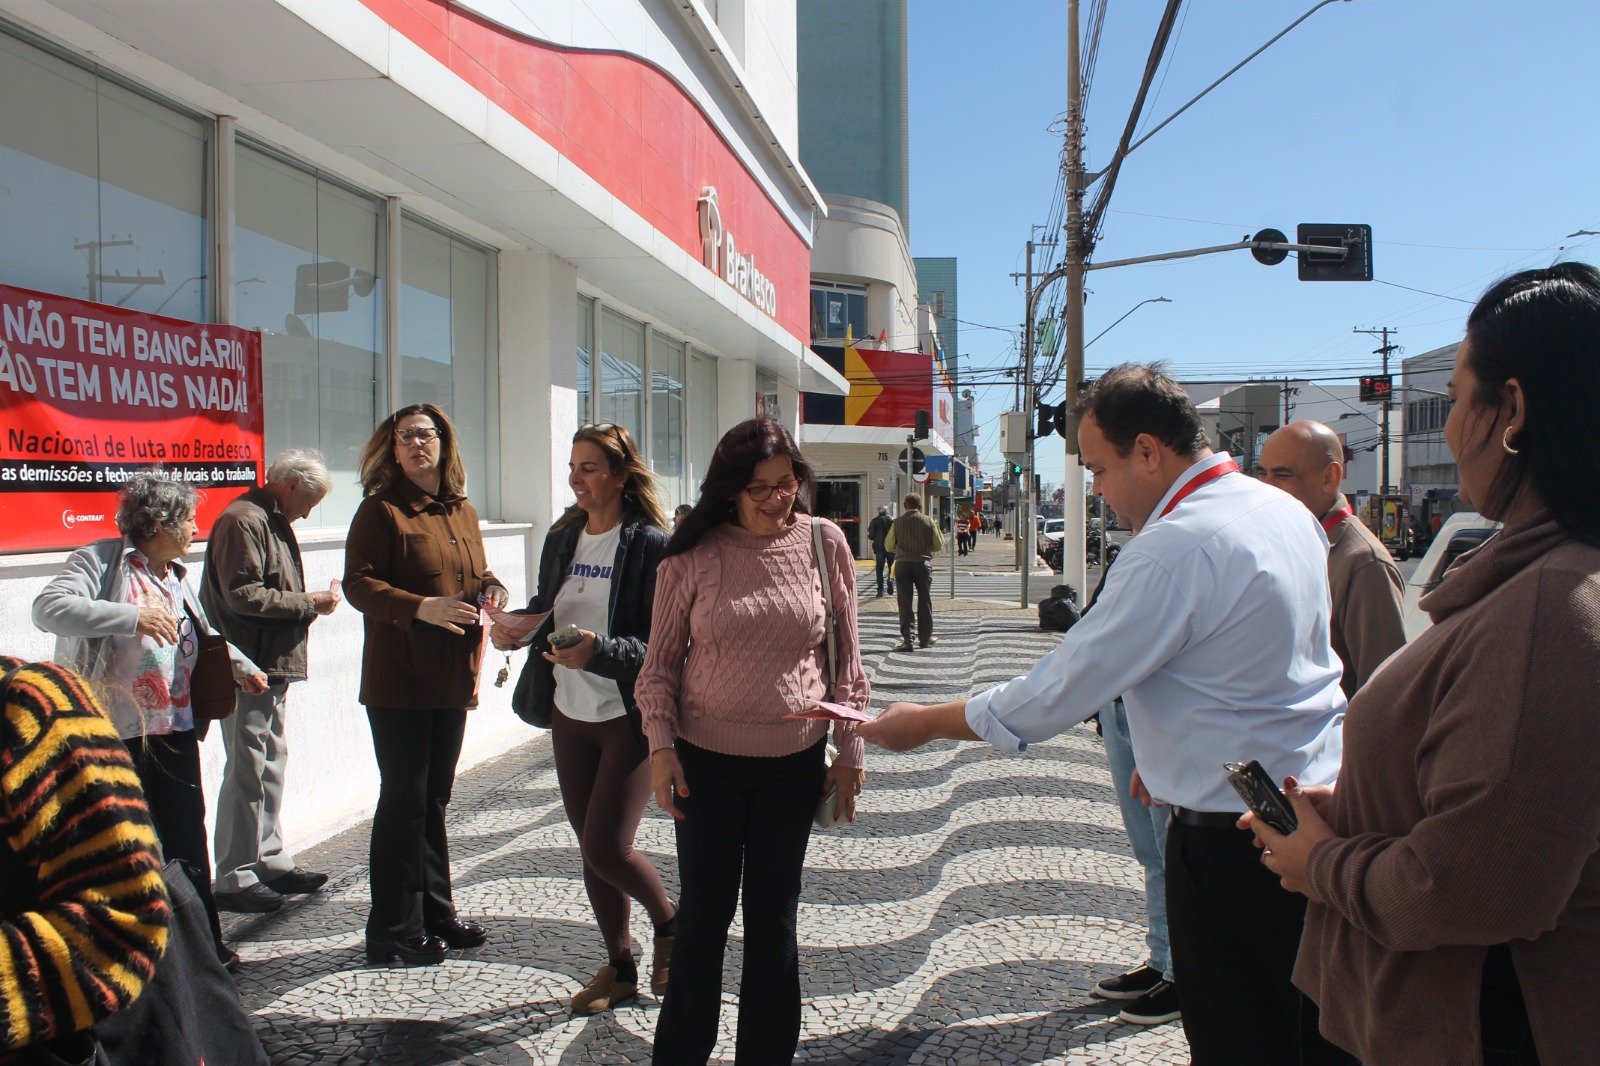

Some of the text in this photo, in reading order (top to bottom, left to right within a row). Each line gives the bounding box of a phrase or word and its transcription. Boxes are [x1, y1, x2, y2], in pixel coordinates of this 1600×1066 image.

[726, 230, 776, 317] Bradesco
[0, 337, 248, 413] ÃO TEM MAIS NADA!
[3, 300, 246, 378] NÃO TEM BANCÁRIO,
[1, 467, 17, 481] as
[20, 464, 93, 482] demissões
[95, 471, 103, 482] e
[171, 468, 182, 482] de
[184, 467, 208, 481] locais
[211, 467, 224, 481] do
[226, 467, 256, 481] trabalho
[8, 428, 251, 459] Nacional de luta no Bradesco
